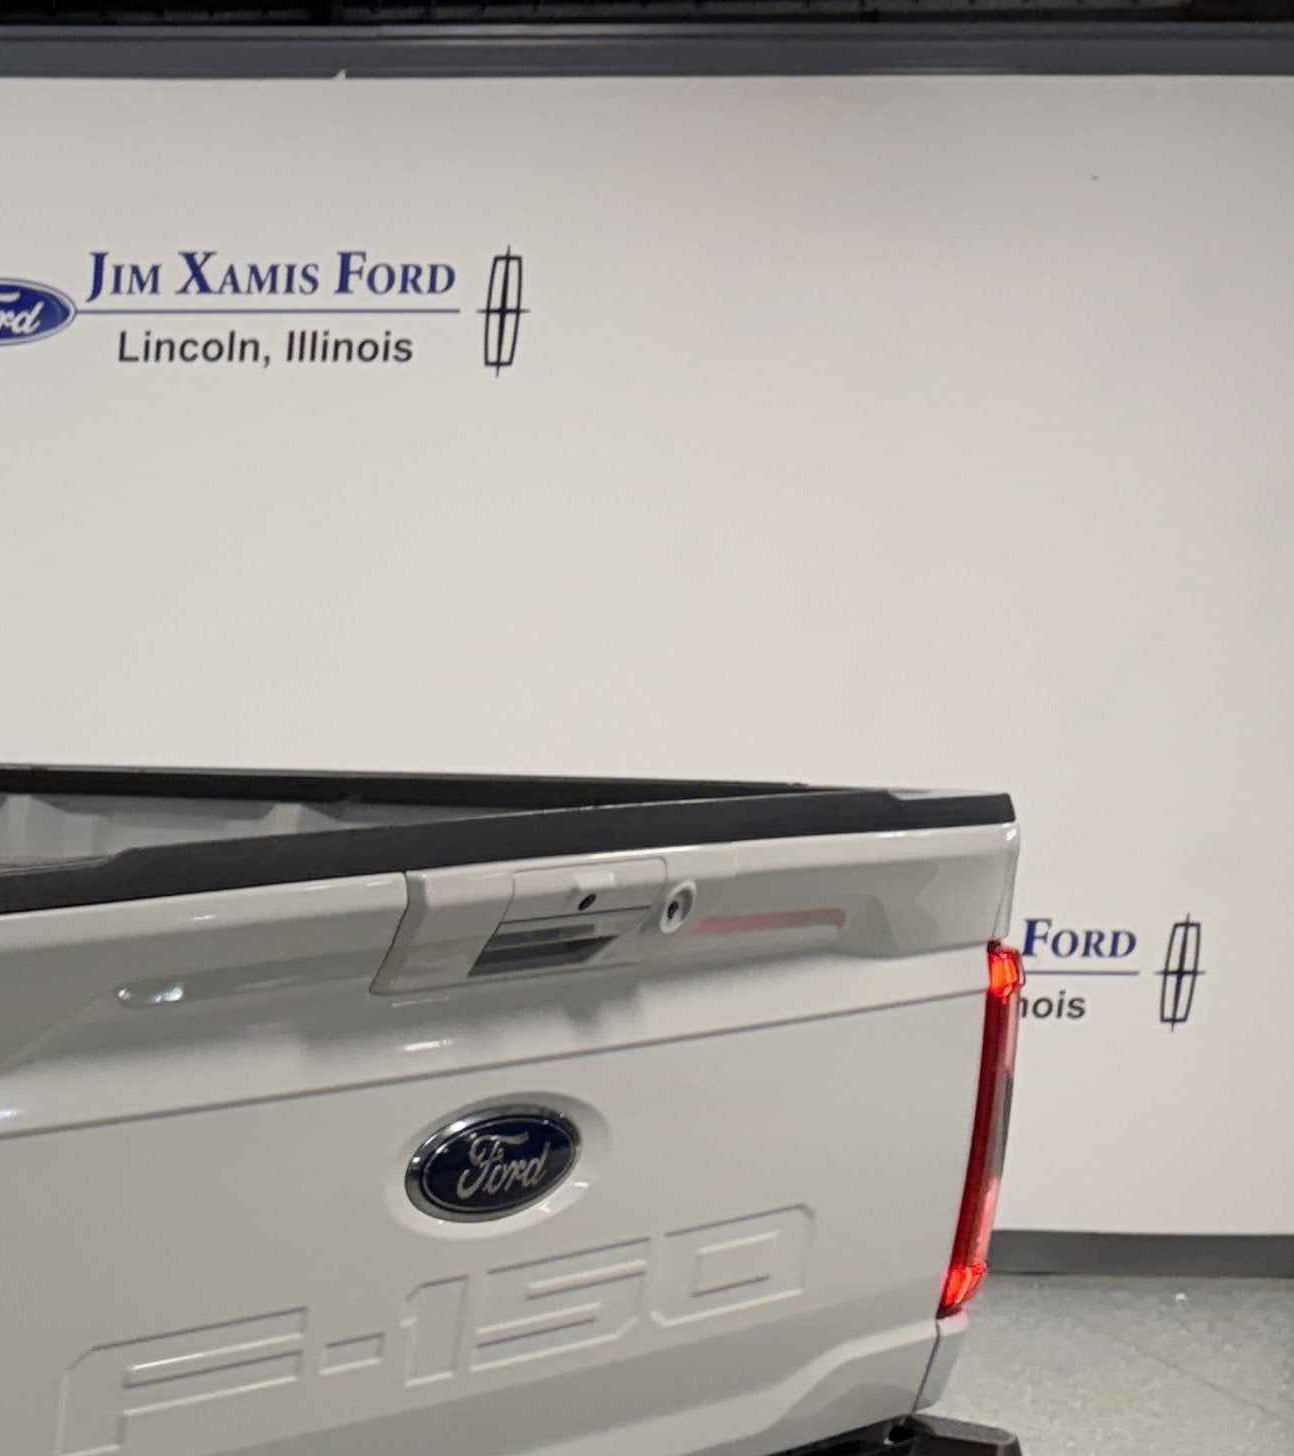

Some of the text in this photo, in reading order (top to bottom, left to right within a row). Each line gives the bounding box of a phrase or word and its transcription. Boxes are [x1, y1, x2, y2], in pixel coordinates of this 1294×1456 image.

[85, 250, 456, 303] JIM XAMIS FORD
[118, 329, 414, 369] Lincoln, Illinois
[1022, 918, 1137, 959] FORD
[456, 1130, 553, 1200] Ford
